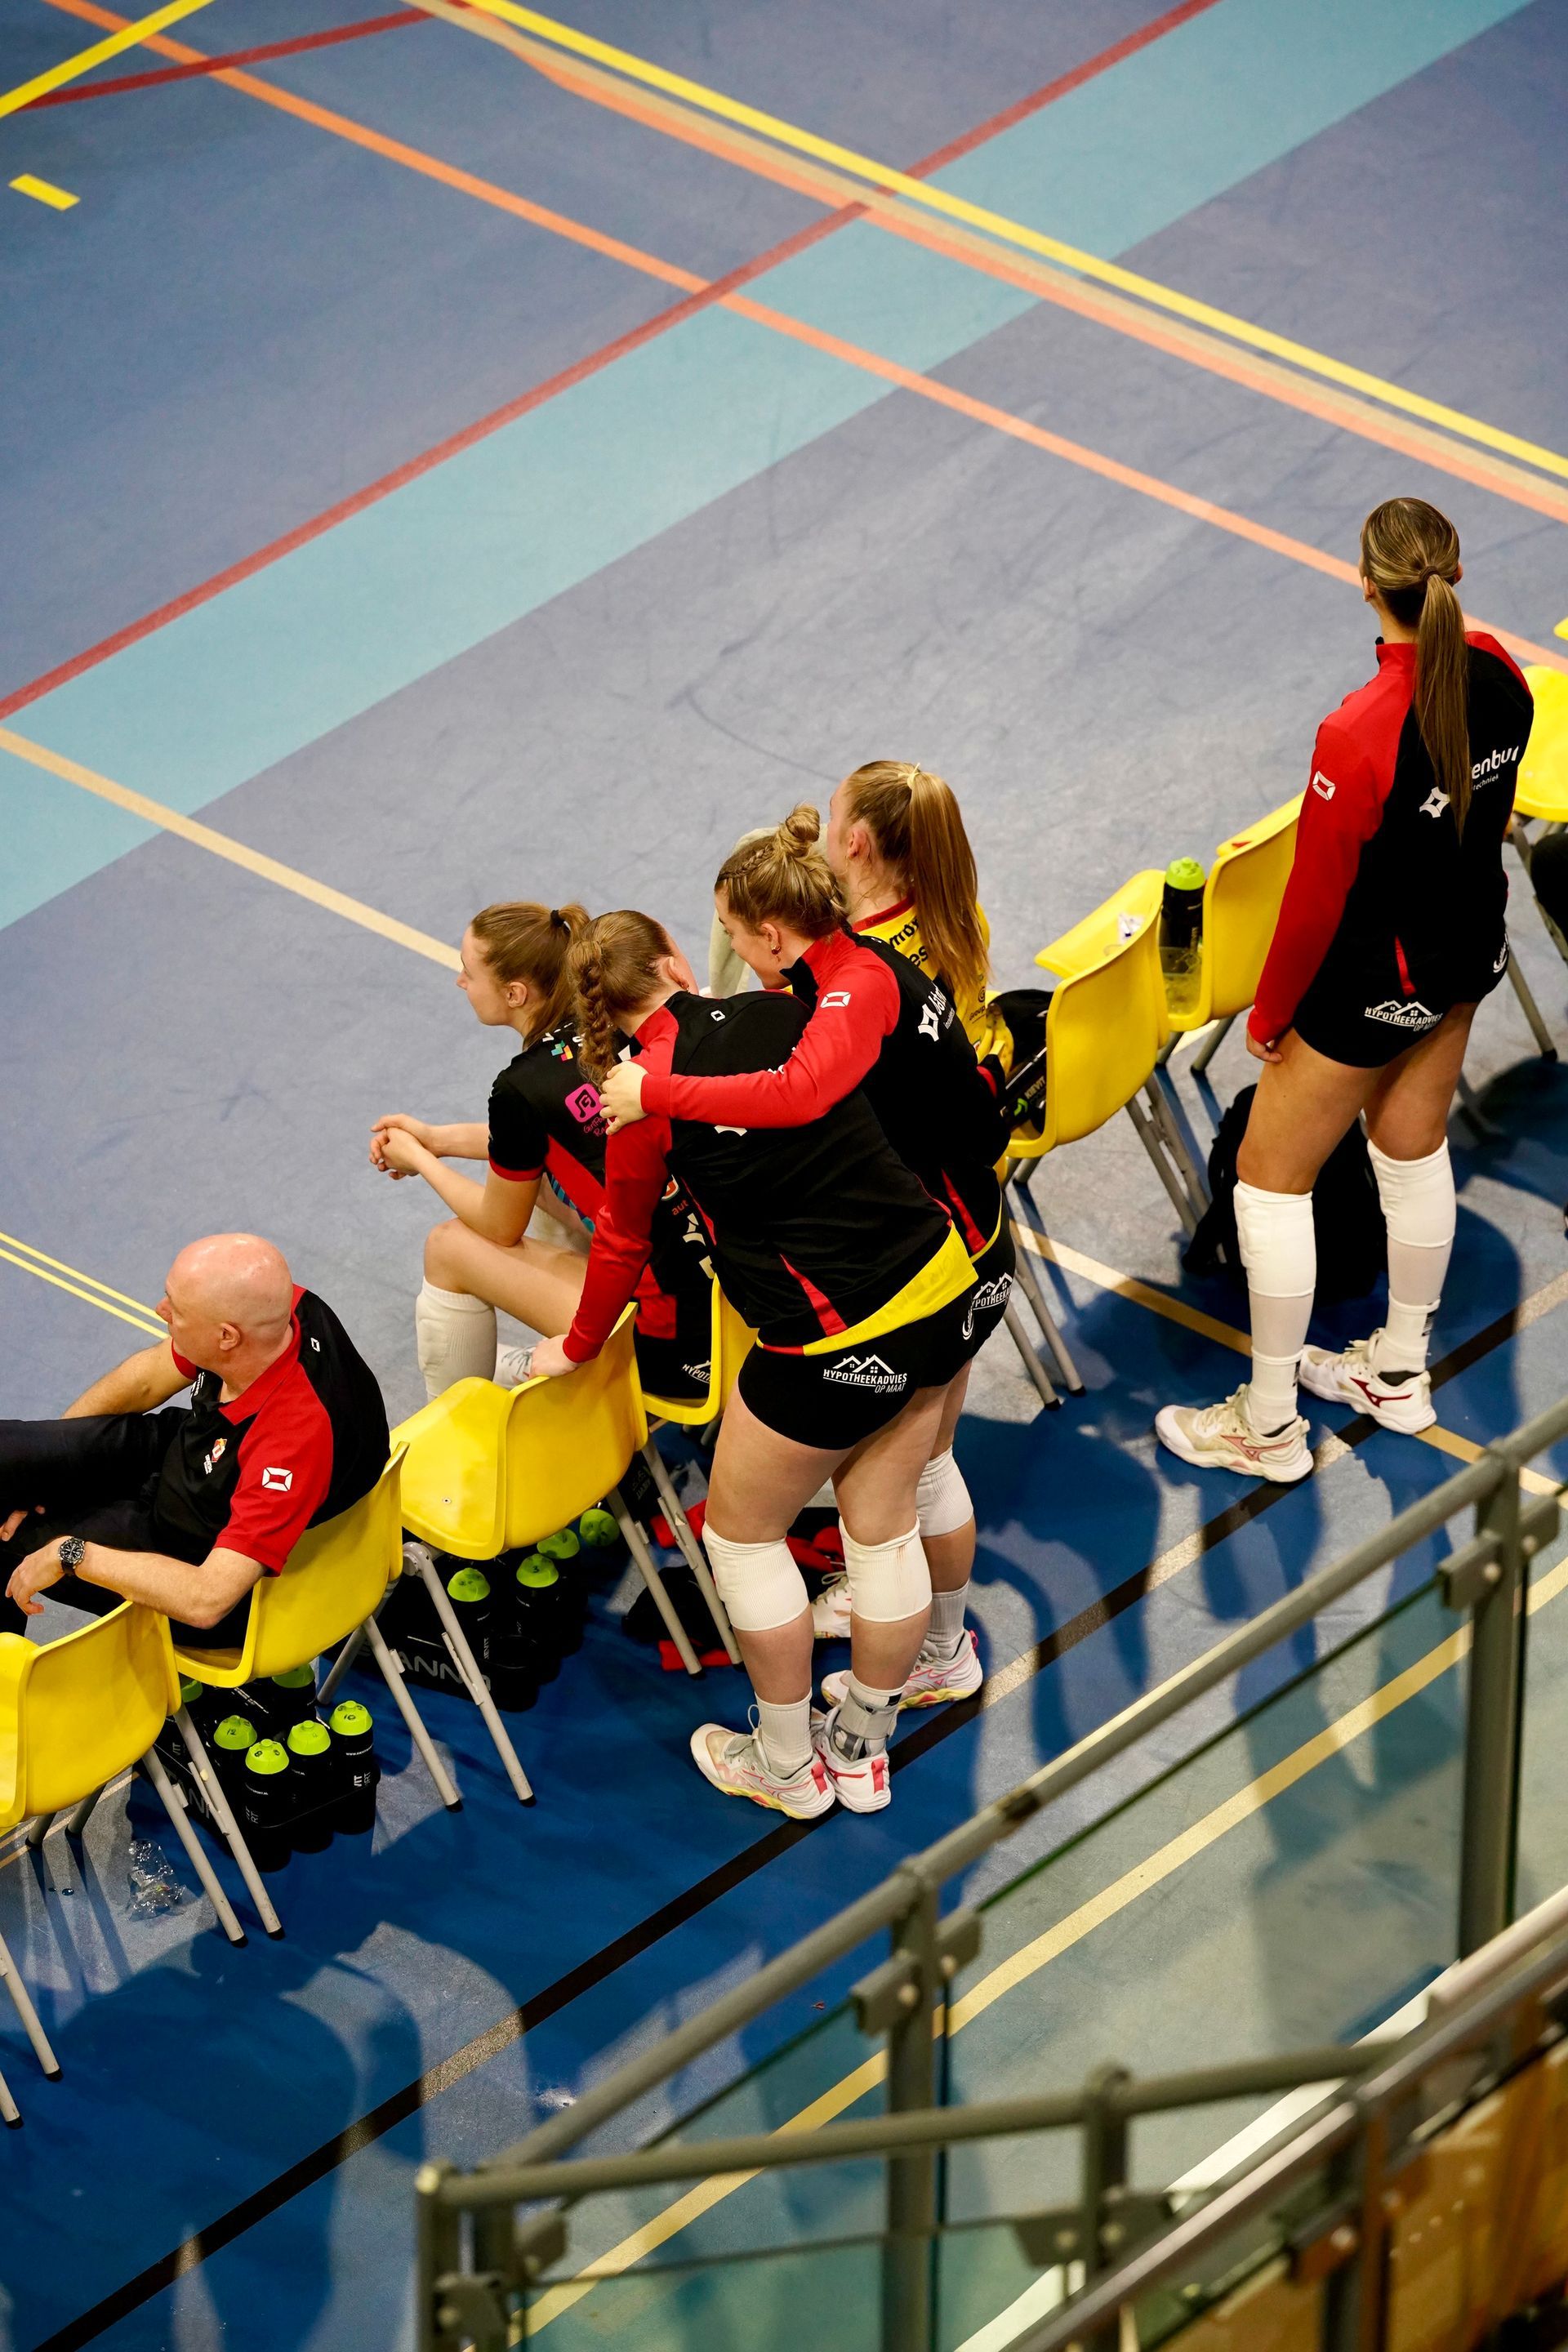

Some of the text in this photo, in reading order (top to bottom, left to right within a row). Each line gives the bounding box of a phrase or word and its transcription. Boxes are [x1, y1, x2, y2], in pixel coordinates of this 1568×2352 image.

[823, 1369, 907, 1384] HYPOTHEEKADVIES
[875, 1383, 906, 1393] OP MAAT
